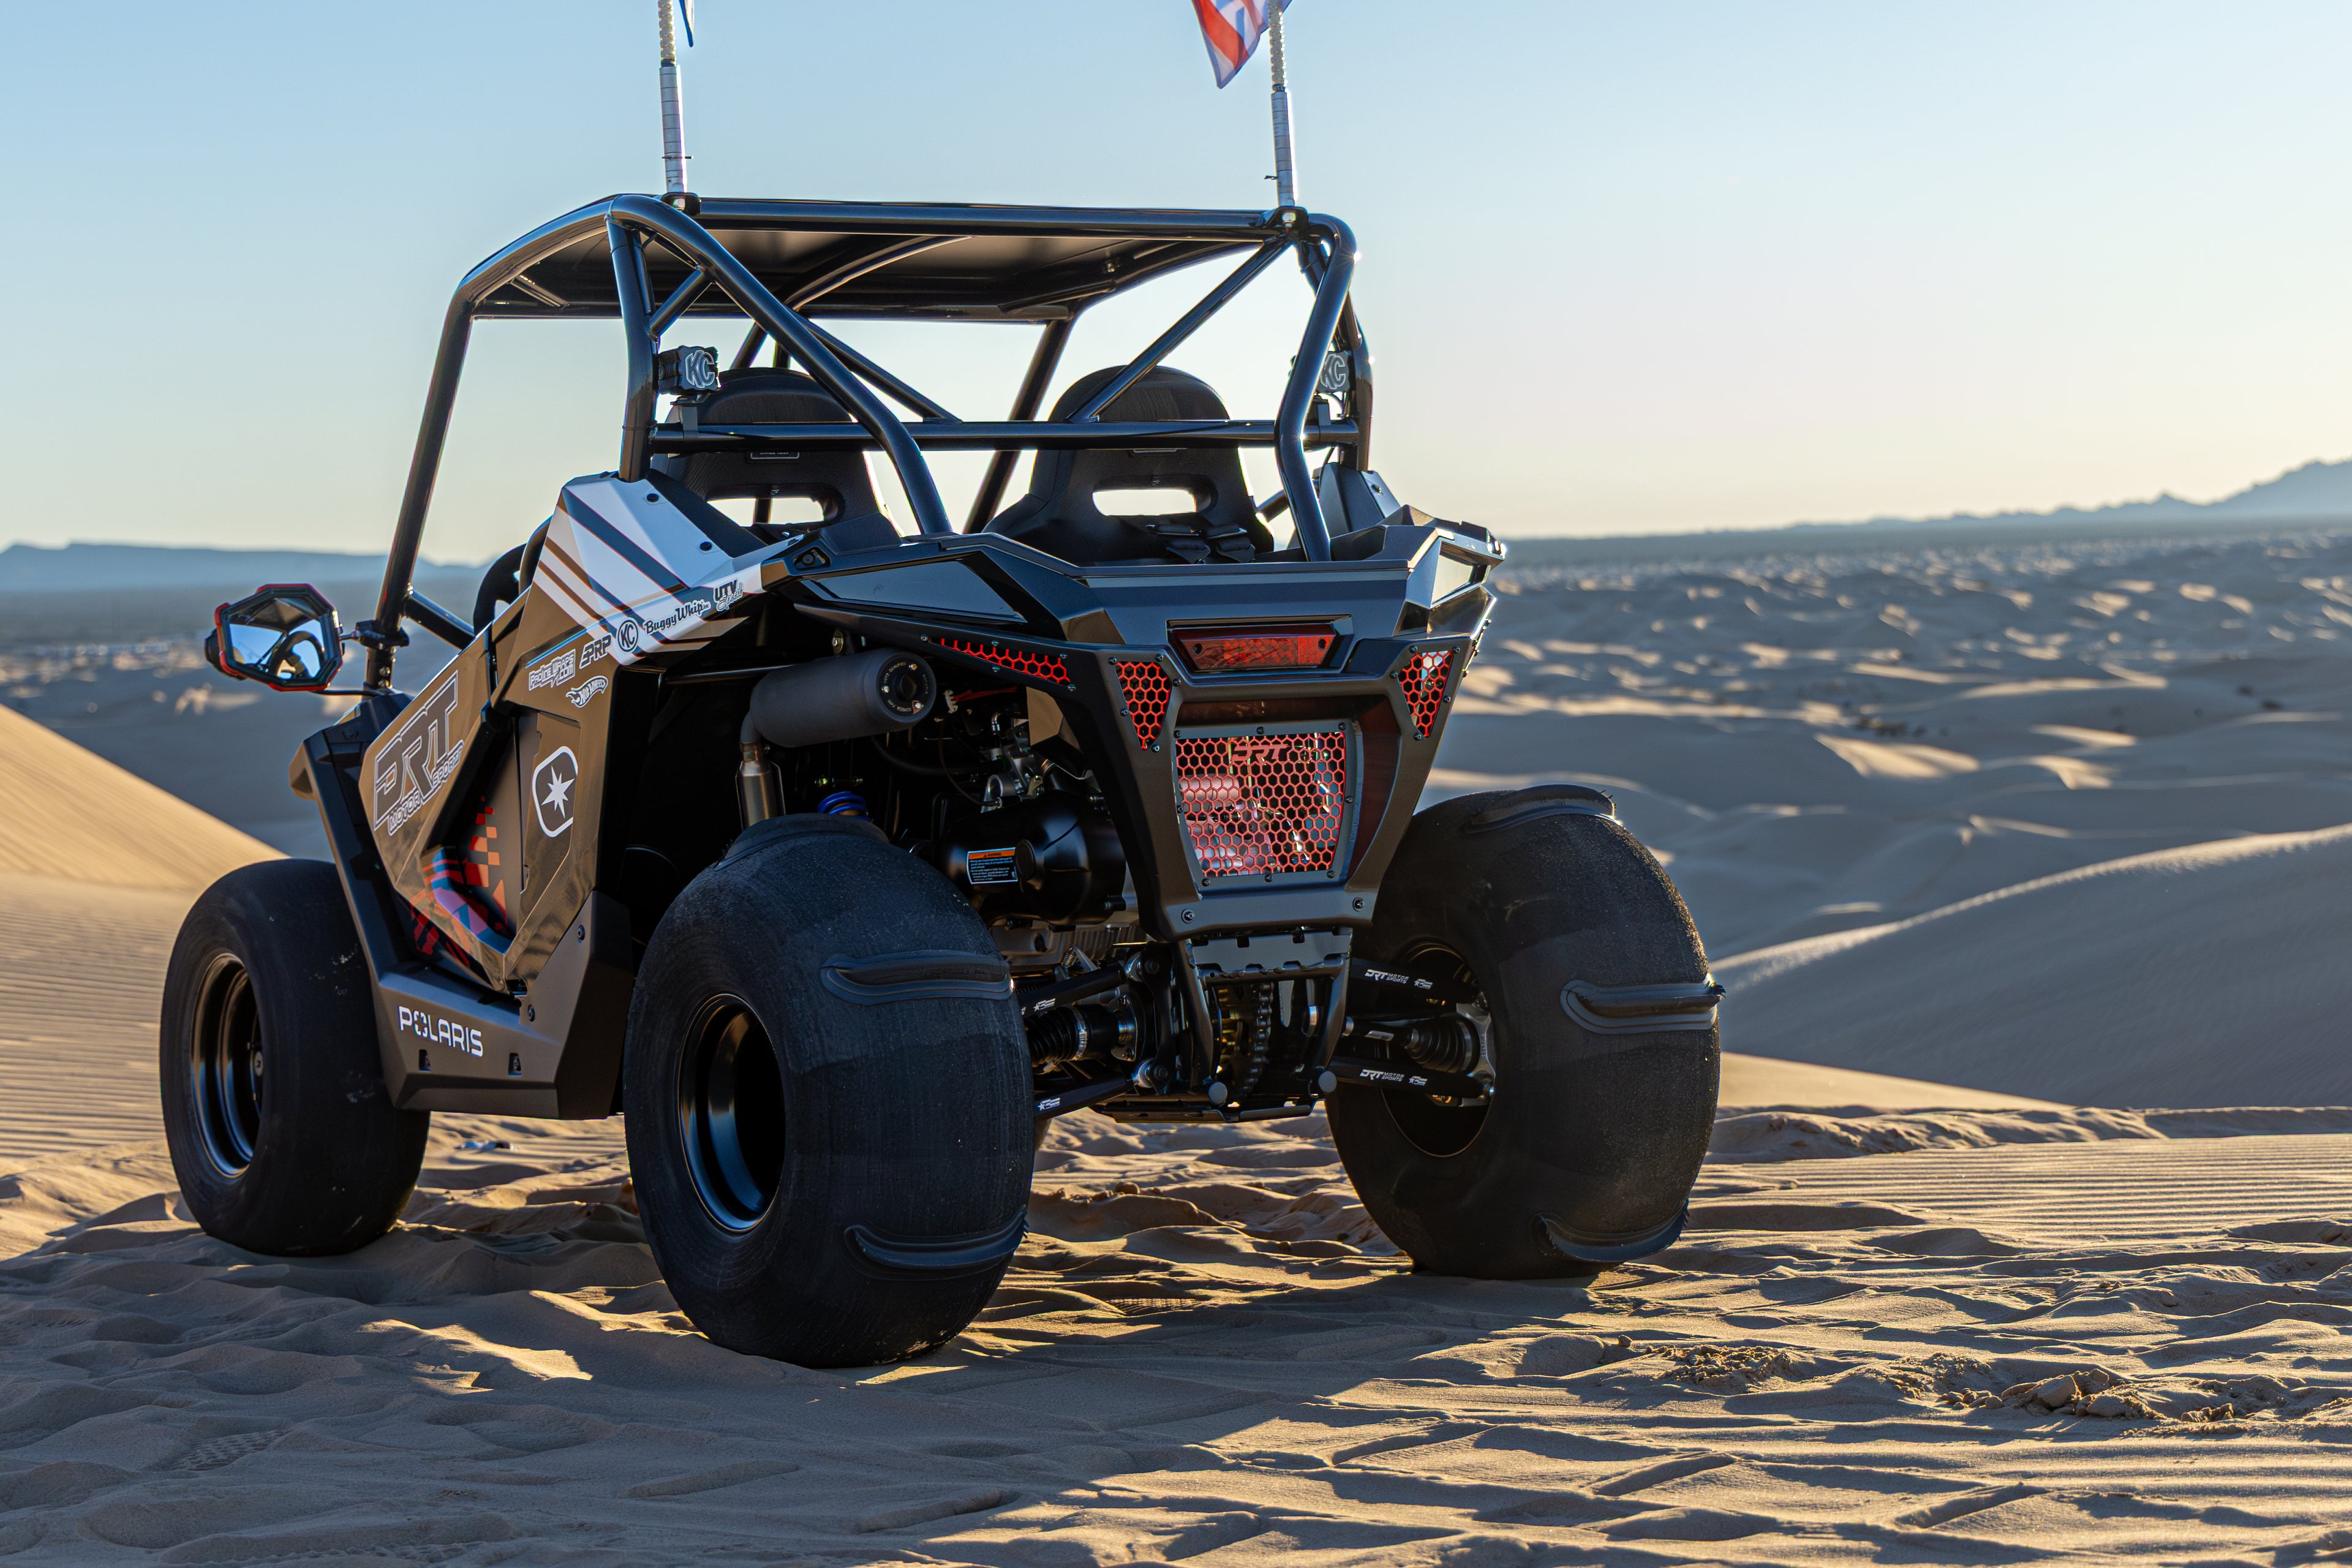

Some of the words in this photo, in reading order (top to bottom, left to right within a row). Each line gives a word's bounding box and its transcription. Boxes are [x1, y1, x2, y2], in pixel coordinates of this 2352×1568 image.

[685, 350, 715, 388] KC
[714, 579, 737, 602] UTV
[717, 582, 743, 611] Speed
[620, 624, 635, 648] KC
[581, 635, 611, 668] PRP
[374, 670, 458, 831] DRT
[1231, 744, 1287, 765] DRT
[389, 790, 421, 831] MOTOR
[1365, 969, 1389, 981] DRT
[399, 1005, 483, 1057] POLARIS
[1360, 1069, 1384, 1080] DRT
